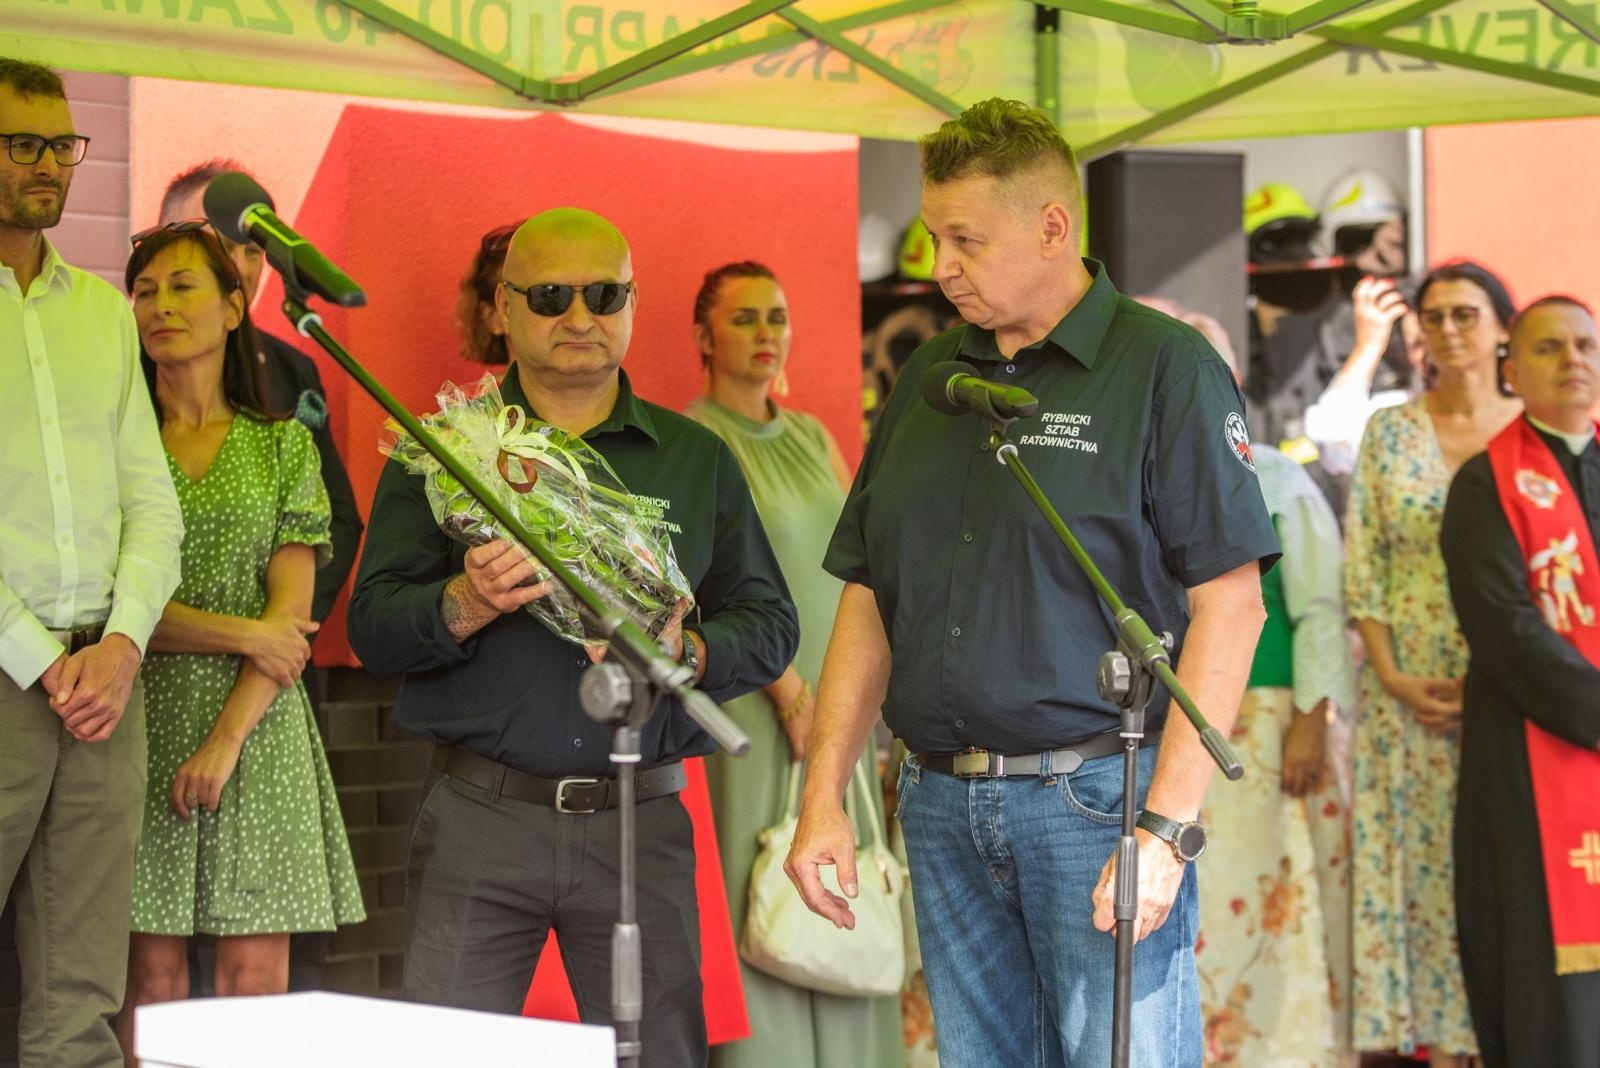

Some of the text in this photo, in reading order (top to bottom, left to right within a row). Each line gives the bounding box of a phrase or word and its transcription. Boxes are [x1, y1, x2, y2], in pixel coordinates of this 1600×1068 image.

[1041, 412, 1091, 426] RYBNICKI
[1044, 424, 1080, 437] SZTAB
[1019, 435, 1099, 454] RATOWNICTWA
